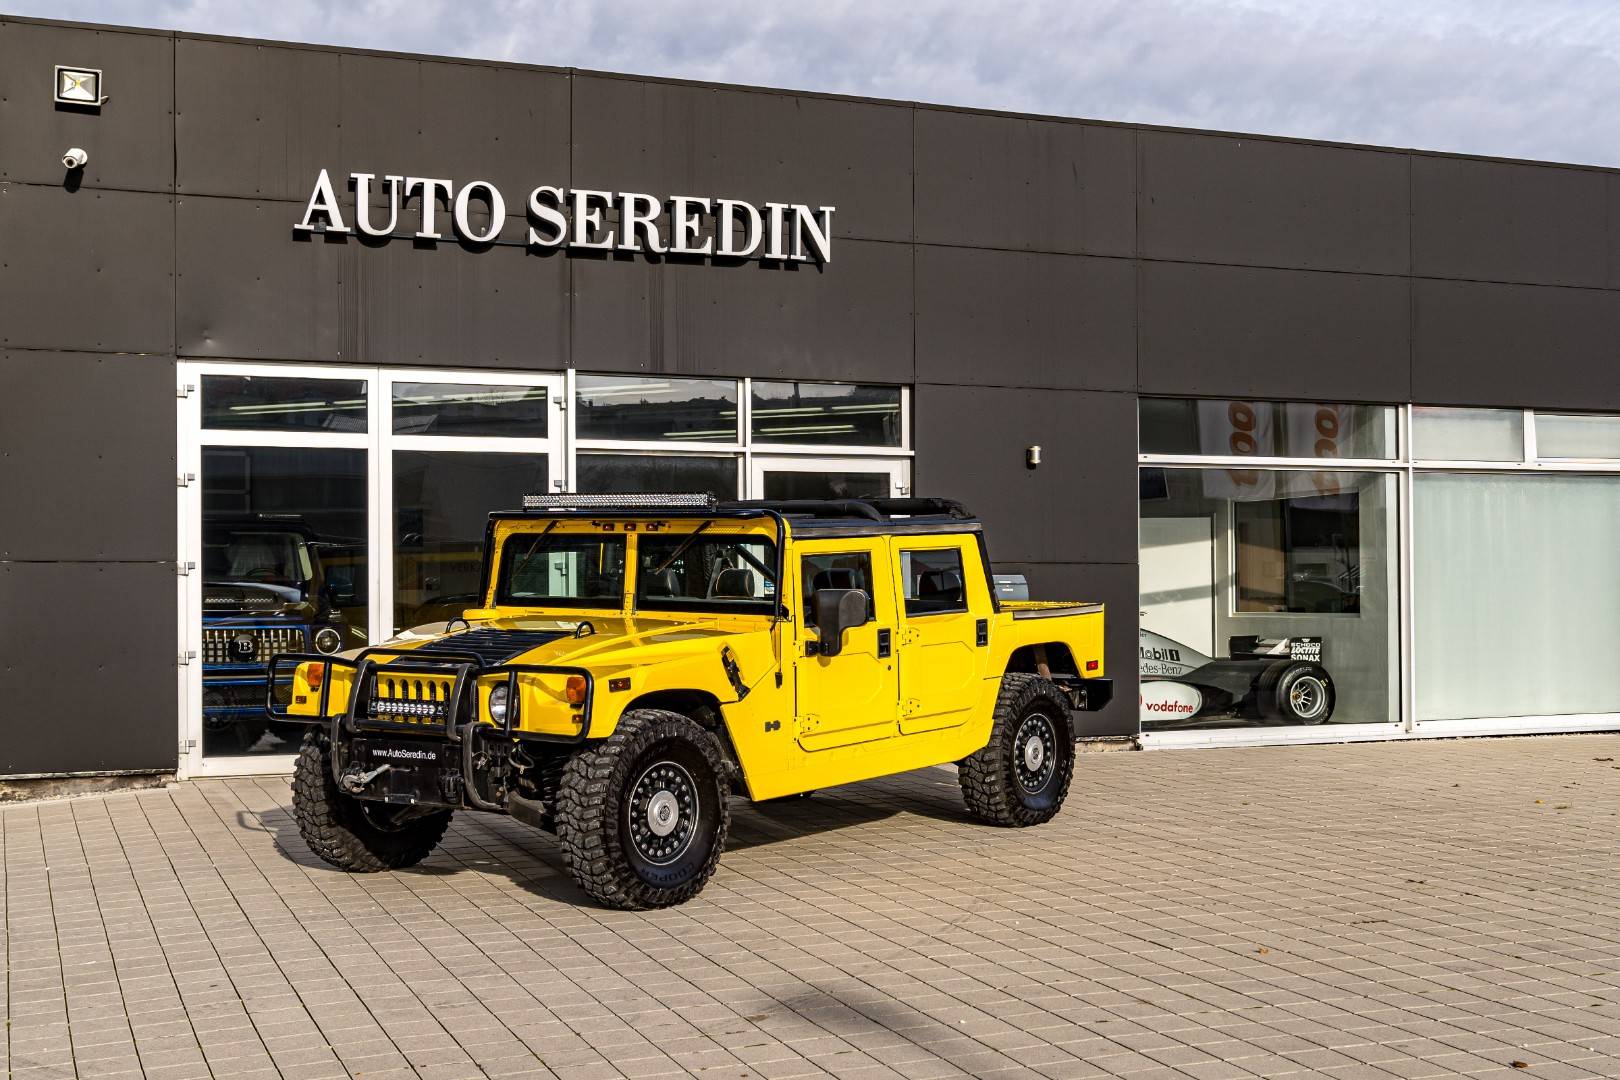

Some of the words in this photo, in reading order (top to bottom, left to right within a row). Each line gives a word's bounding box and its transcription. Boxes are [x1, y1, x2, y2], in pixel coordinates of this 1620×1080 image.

[294, 168, 506, 242] AUTO
[527, 185, 836, 263] SEREDIN
[1290, 654, 1320, 662] SONAX
[1140, 663, 1182, 675] des-Benz
[1145, 700, 1193, 713] vodafone
[372, 748, 436, 760] www.AutoSeredin.de
